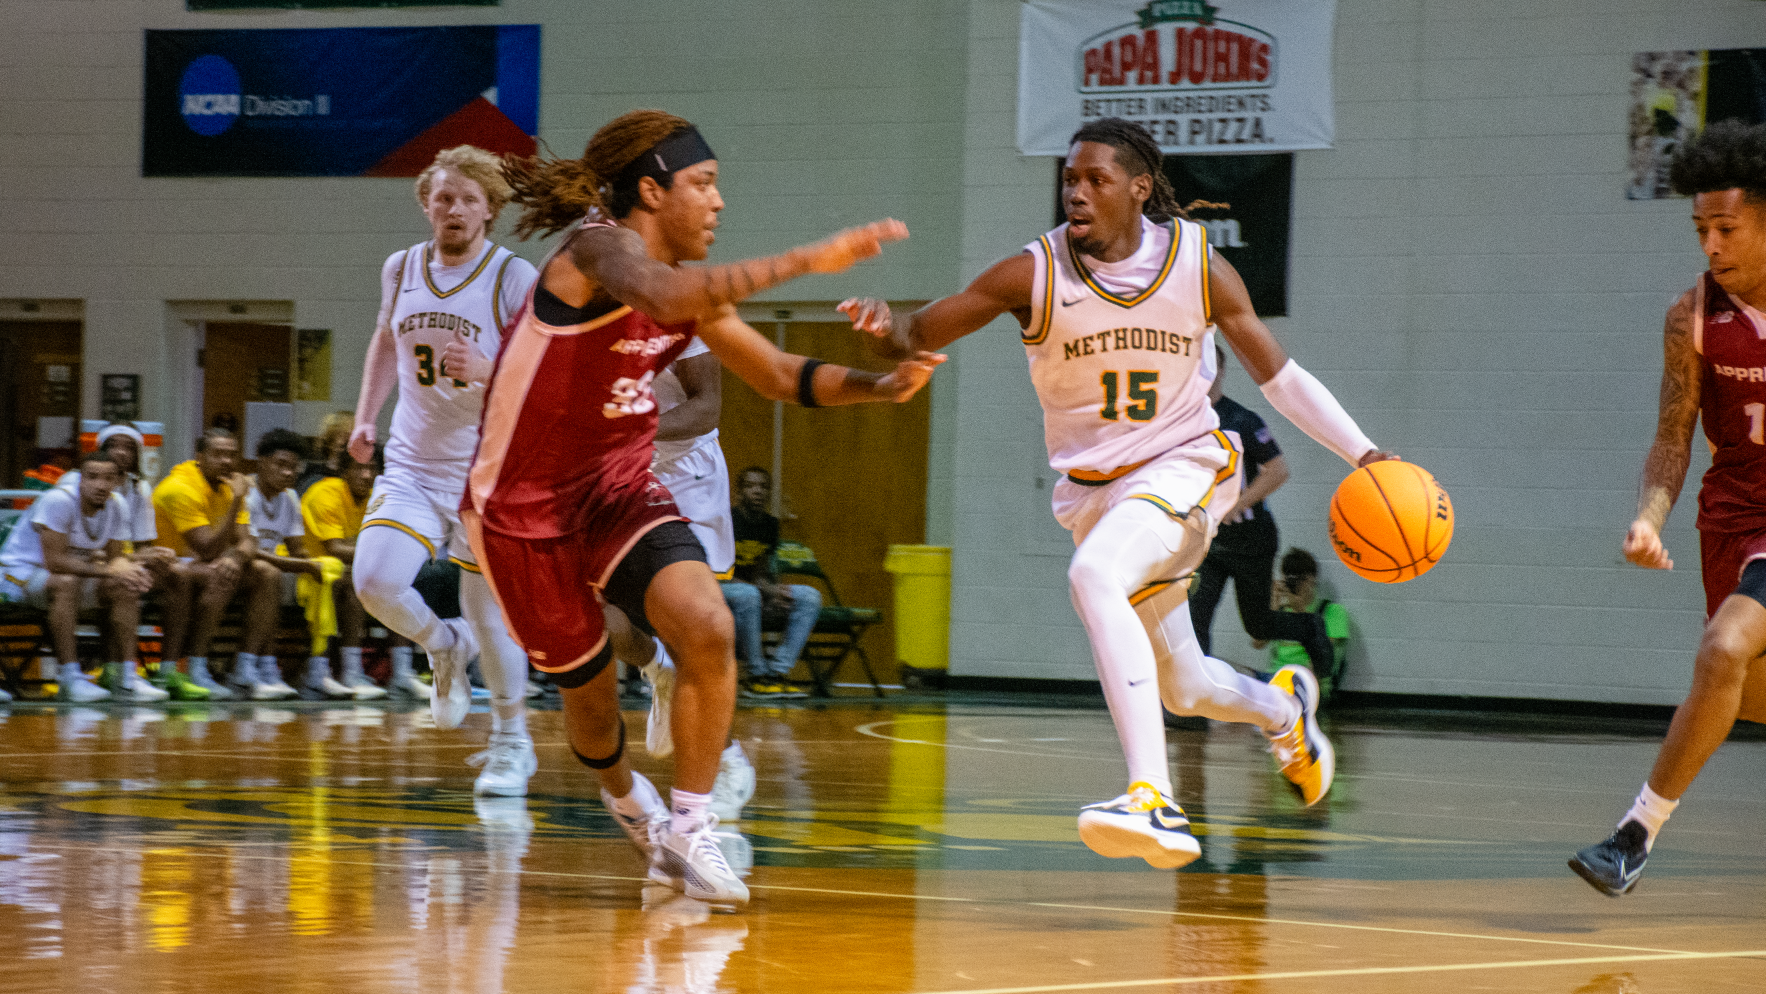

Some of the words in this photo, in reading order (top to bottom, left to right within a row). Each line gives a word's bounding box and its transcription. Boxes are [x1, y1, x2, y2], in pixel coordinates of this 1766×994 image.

[1084, 29, 1161, 86] PAPA
[181, 94, 241, 116] NCAA
[243, 94, 313, 116] Division
[1082, 98, 1148, 117] BETTER
[398, 311, 482, 342] METHODIST
[1063, 327, 1192, 361] METHODIST
[1714, 363, 1766, 383] APPR
[1100, 370, 1160, 422] 15
[1744, 402, 1766, 446] 1
